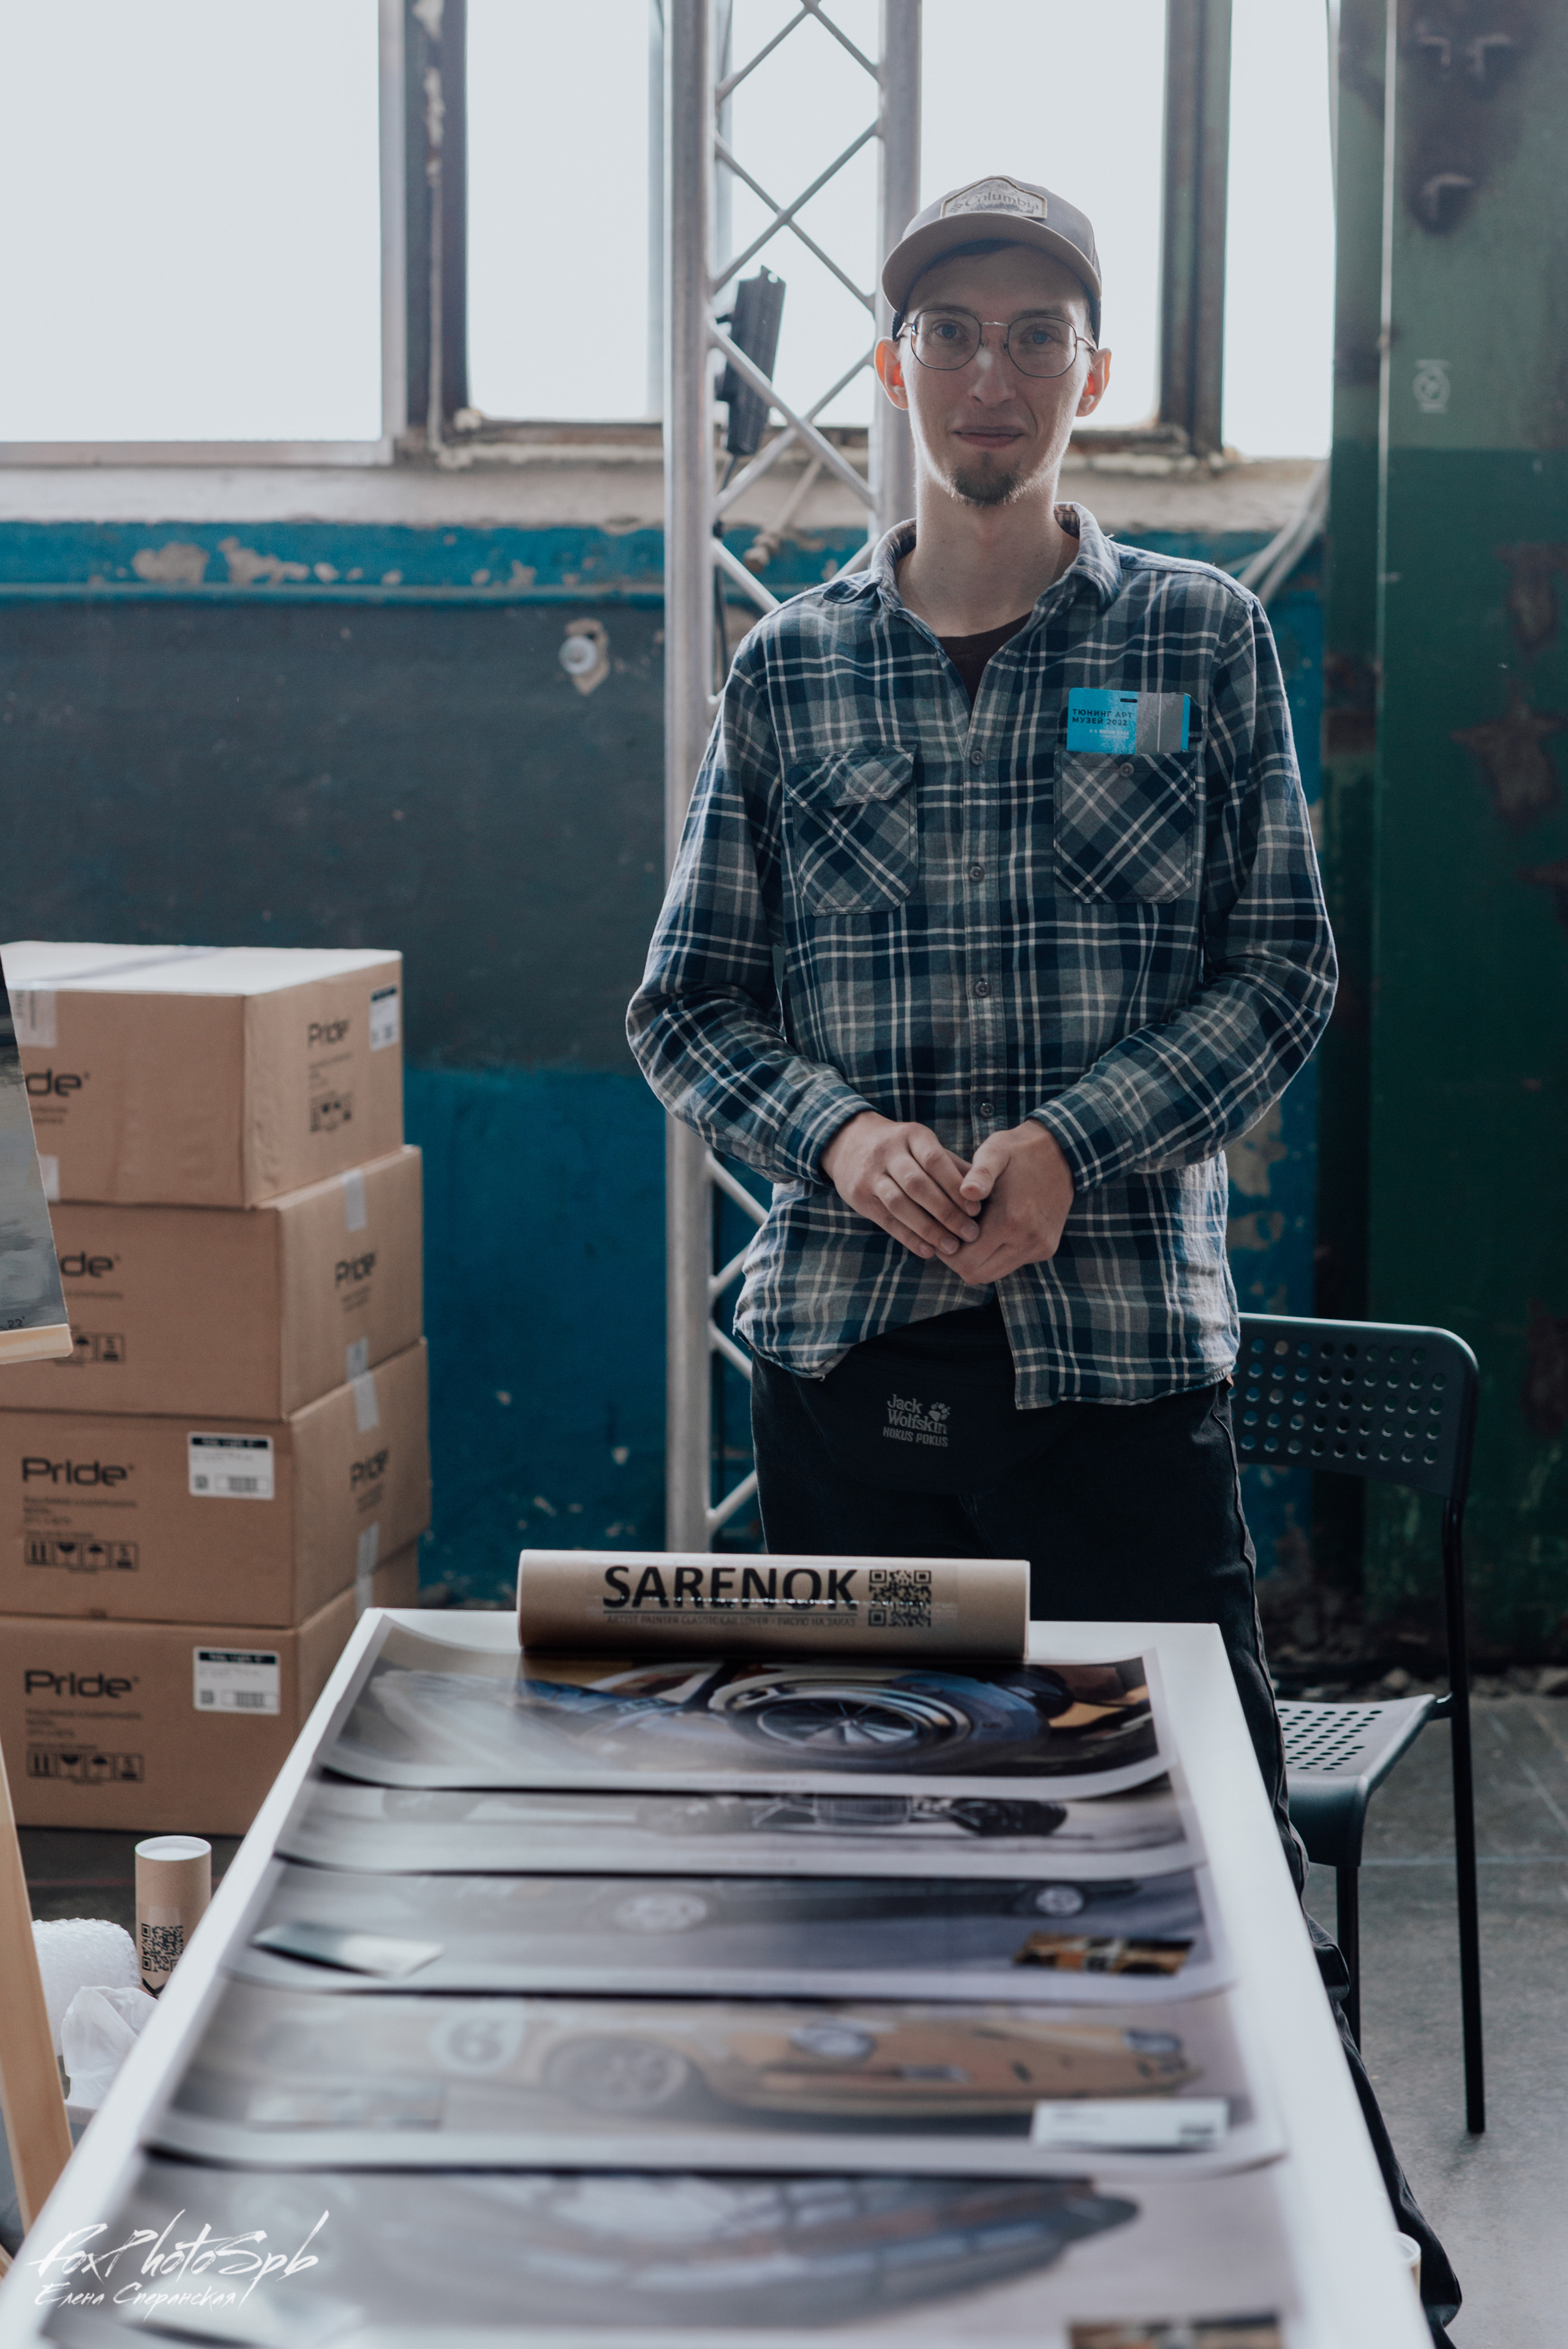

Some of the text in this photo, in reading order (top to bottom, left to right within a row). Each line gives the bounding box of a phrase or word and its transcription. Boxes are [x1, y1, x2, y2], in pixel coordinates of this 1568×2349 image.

[965, 192, 1039, 210] Columbia
[1072, 708, 1112, 717] ТЮНИНГ
[886, 1394, 923, 1414] Jack
[887, 1408, 948, 1434] Wolfskin
[916, 1432, 948, 1447] POKUS
[22, 1458, 127, 1486] Pride
[603, 1565, 858, 1610] SARENOK
[24, 1670, 133, 1698] Pride
